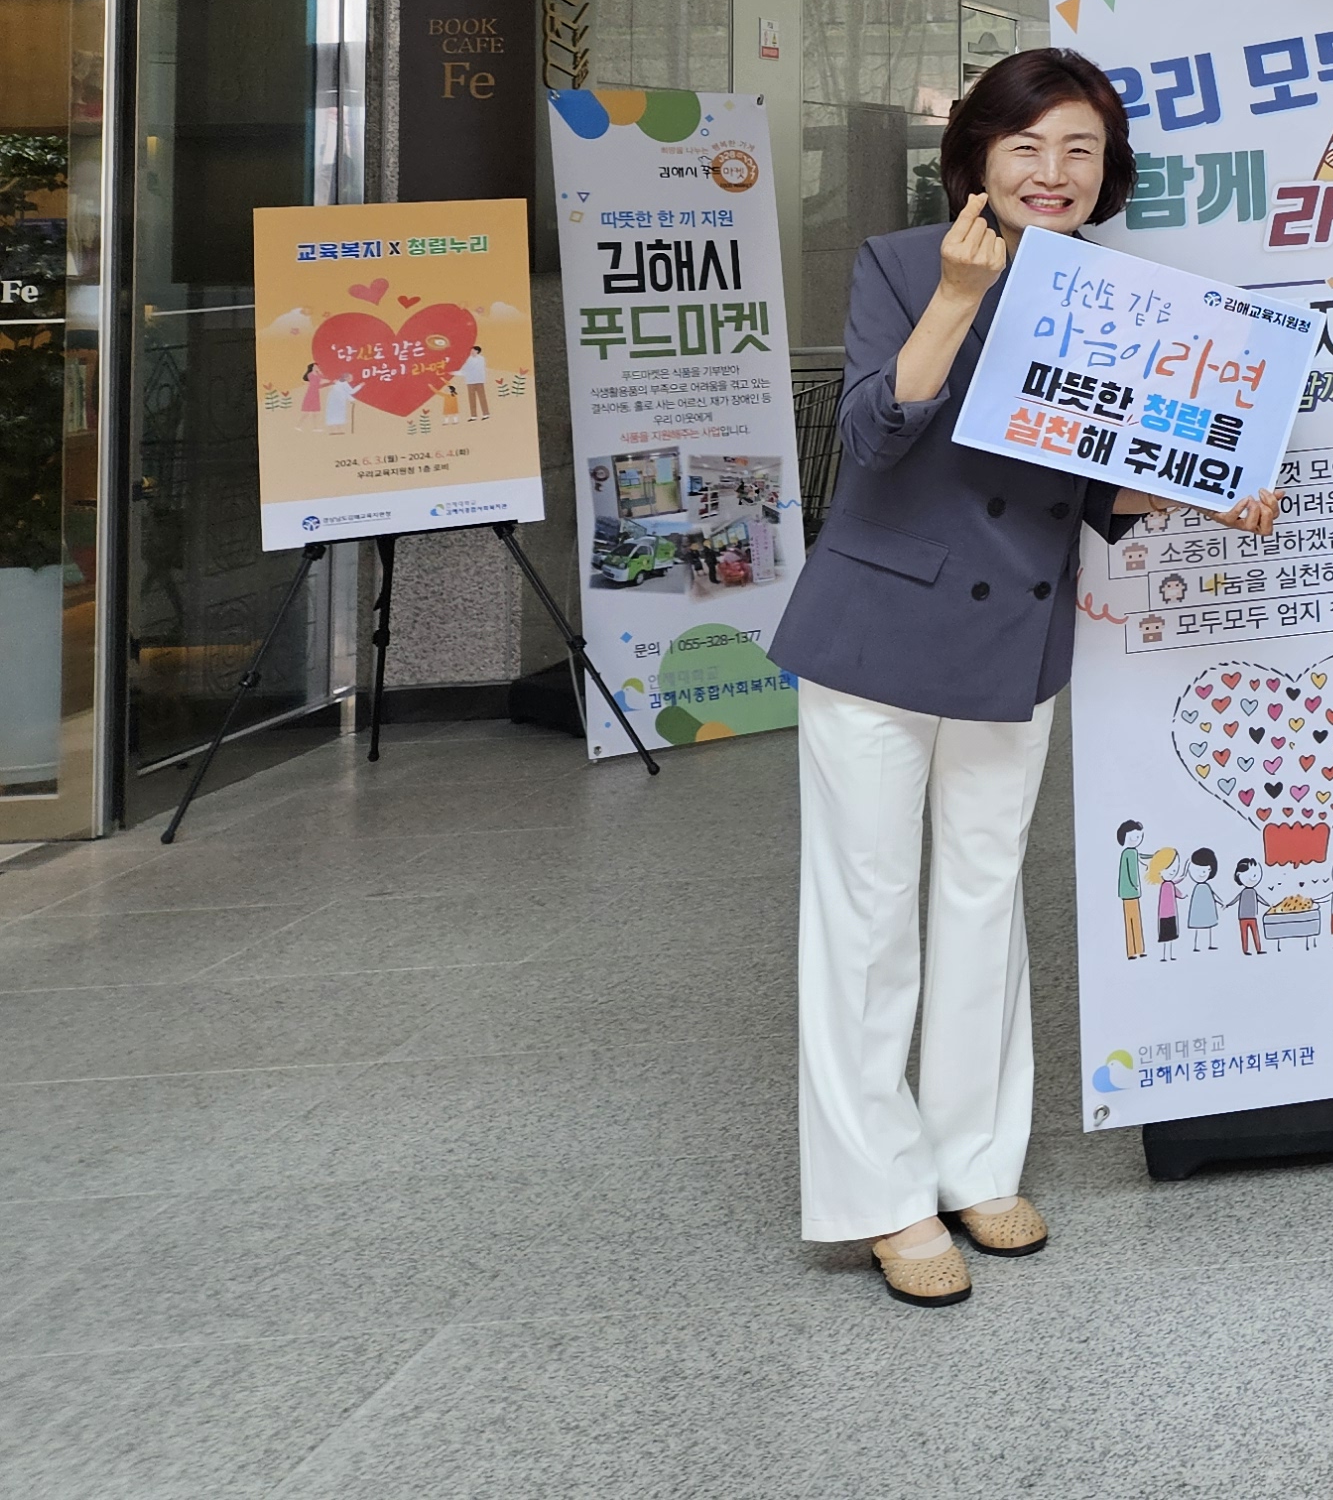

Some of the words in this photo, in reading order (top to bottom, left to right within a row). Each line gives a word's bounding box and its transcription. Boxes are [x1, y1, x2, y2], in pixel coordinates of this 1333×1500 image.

[429, 18, 498, 36] BOOK
[442, 37, 504, 54] CAFE
[441, 61, 495, 99] Fe
[1125, 149, 1268, 231] 함께
[601, 211, 652, 228] 따뜻한
[657, 211, 675, 228] 한
[680, 210, 696, 227] 끼
[701, 210, 733, 227] 지원
[297, 241, 382, 261] 교육복지
[407, 235, 488, 256] 청렴누리
[597, 239, 741, 294] 김해시
[1, 281, 39, 303] Fe
[1052, 266, 1116, 310] 당신도
[1130, 289, 1173, 326] 같은
[1223, 296, 1312, 334] 김해교육지원청
[579, 301, 772, 360] 푸드마켓
[392, 341, 425, 360] 같은
[362, 364, 406, 382] 마음이
[622, 369, 670, 381] 푸드마켓은
[672, 367, 701, 378] 식품을
[702, 365, 740, 377] 기부받아
[650, 384, 688, 395] 부족으로
[690, 381, 727, 392] 어려움을
[751, 378, 771, 389] 있는
[657, 400, 675, 410] 사는
[762, 393, 772, 403] 등
[1020, 361, 1134, 422] 따뜻한
[1140, 393, 1245, 453] 청렴을
[653, 414, 672, 425] 우리
[675, 412, 713, 424] 이웃에게
[1004, 406, 1118, 466] 실천해
[1124, 437, 1244, 500] 주세요!
[1159, 537, 1228, 565] 소중히
[1199, 569, 1267, 597] 나눔을
[1176, 608, 1269, 637] 모두모두
[1277, 600, 1320, 628] 엄지
[633, 642, 661, 658] 문의
[678, 630, 761, 652] 055-328-1377
[649, 674, 791, 709] 김해시종합사회복지관
[1137, 1034, 1226, 1065] 인제대학교
[1138, 1045, 1316, 1088] 김해시종합사회복지관
